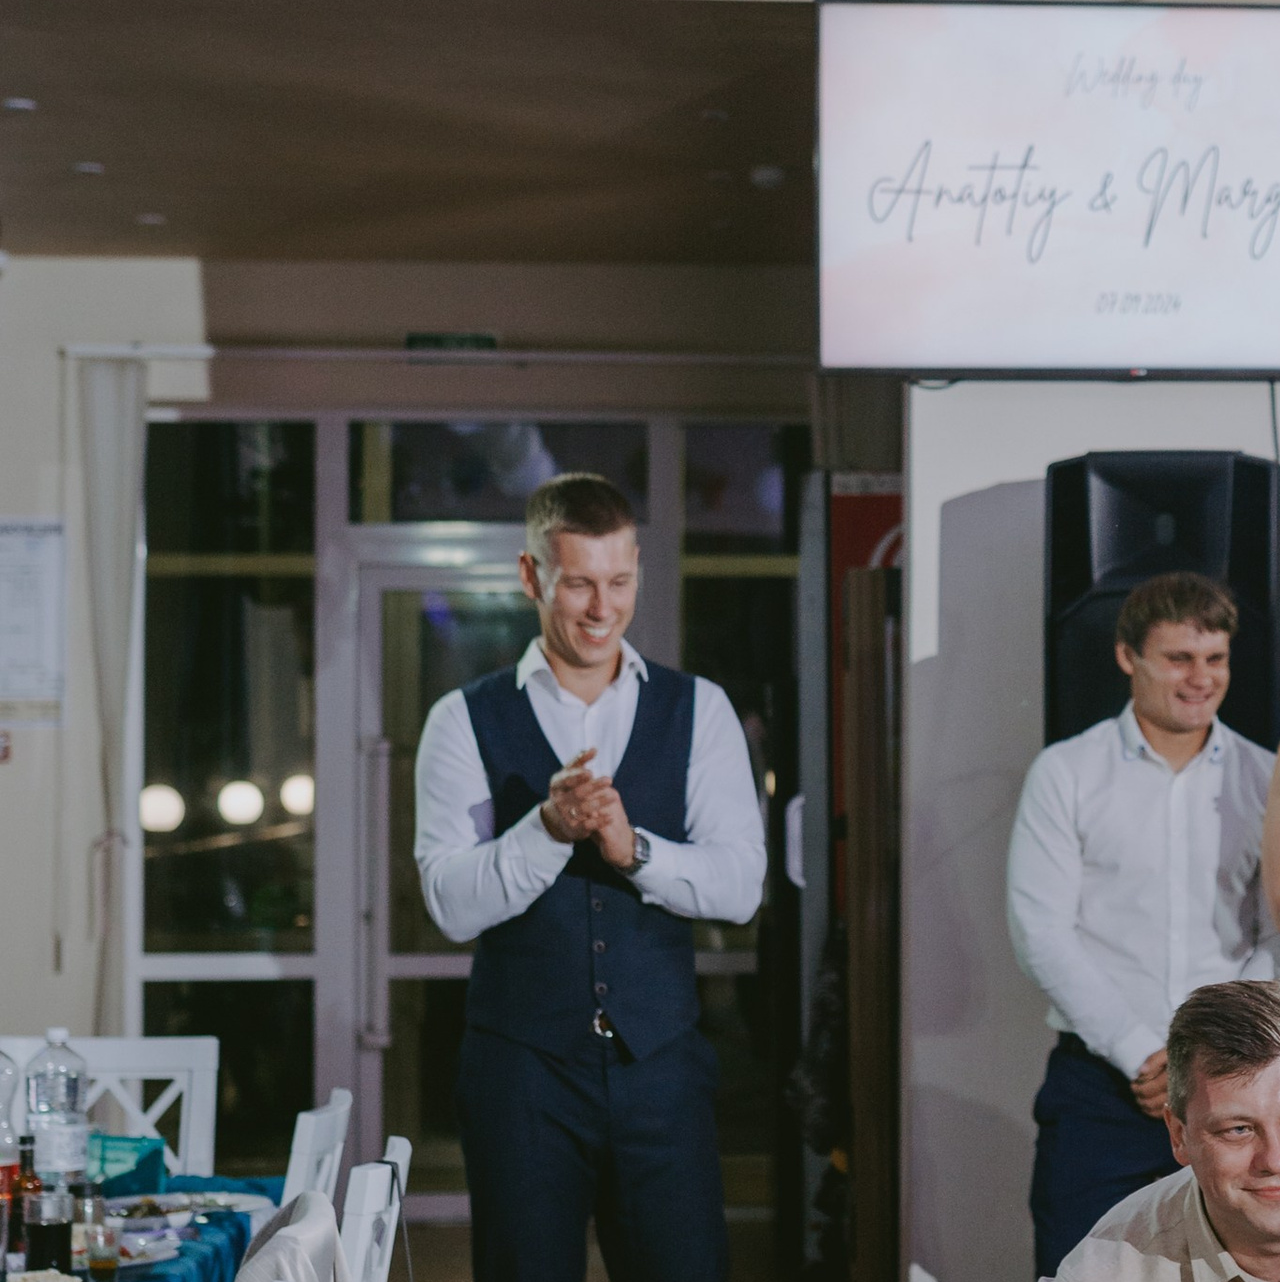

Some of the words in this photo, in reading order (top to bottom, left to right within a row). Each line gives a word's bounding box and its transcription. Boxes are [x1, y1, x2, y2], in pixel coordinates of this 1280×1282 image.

[1064, 50, 1160, 109] Wedding
[1171, 56, 1206, 112] day
[1088, 172, 1118, 214] &
